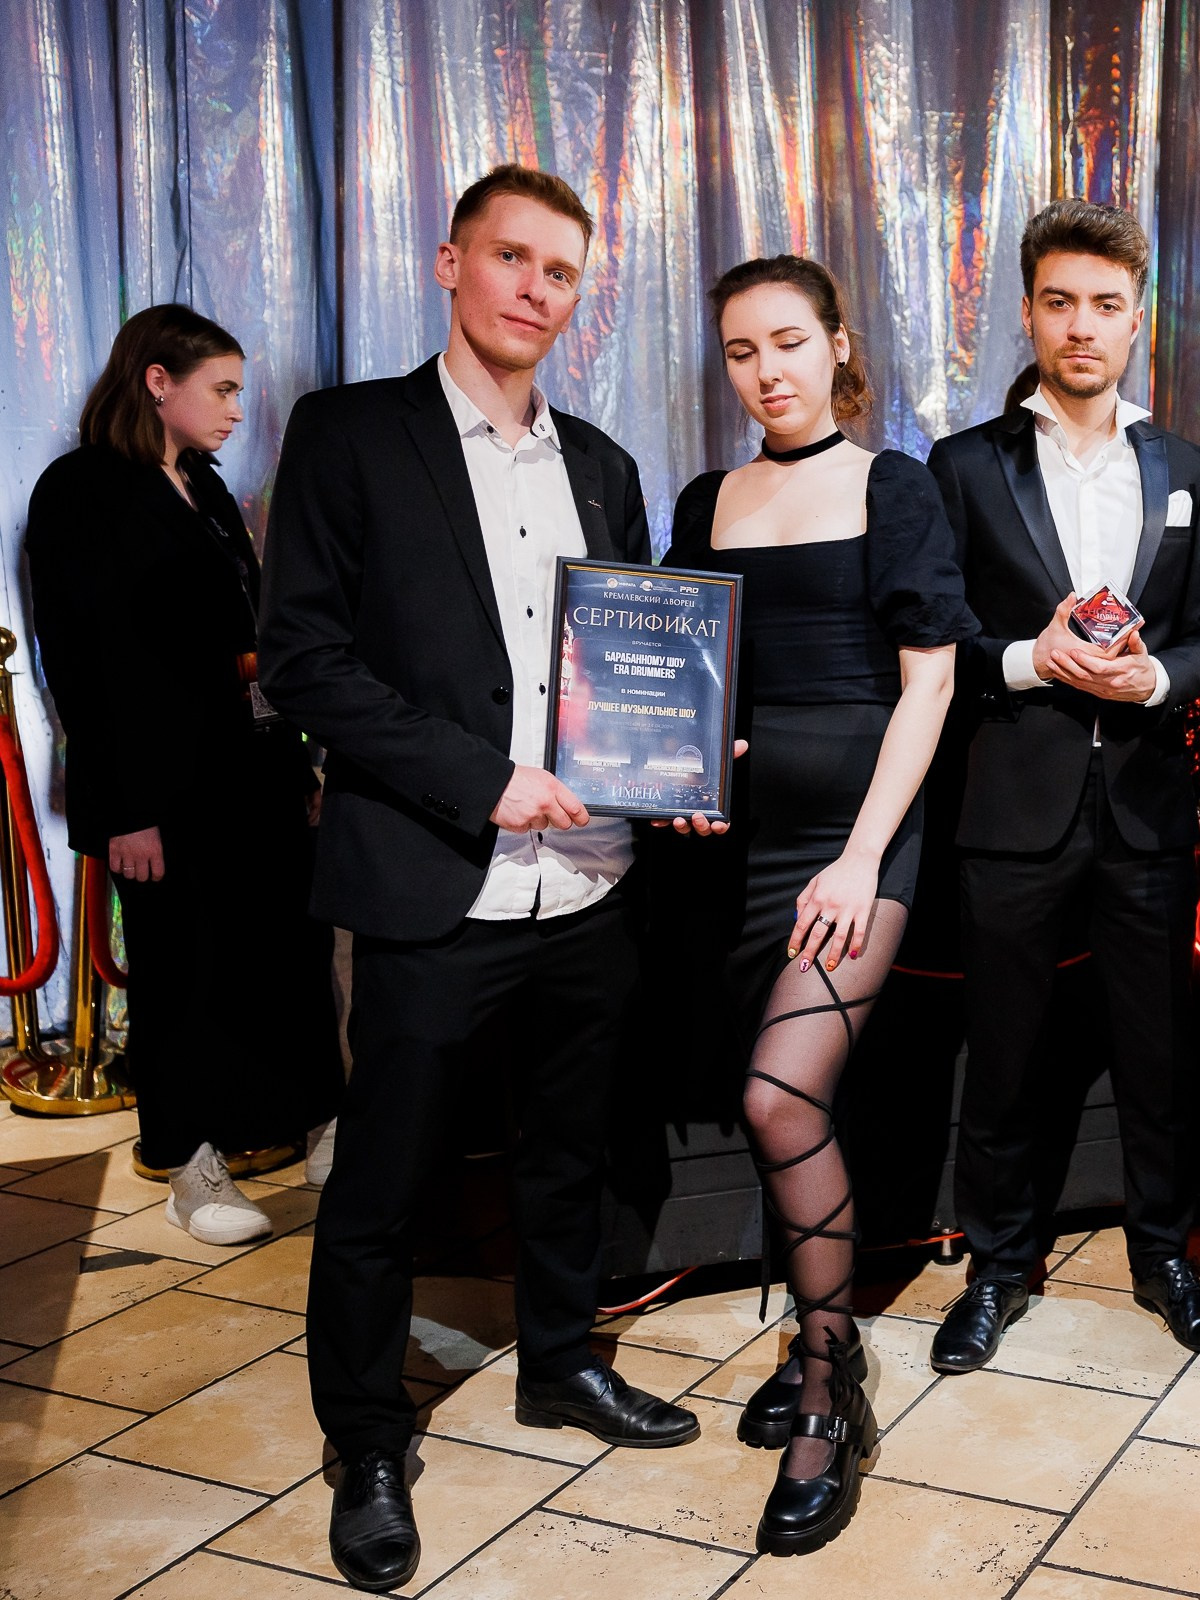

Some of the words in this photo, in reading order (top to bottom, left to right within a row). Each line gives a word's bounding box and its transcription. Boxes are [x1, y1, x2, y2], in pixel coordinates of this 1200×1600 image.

[680, 586, 699, 594] PRO
[603, 591, 660, 604] КРЕМЛЕВСКИЙ
[663, 598, 695, 607] ДВОРЕЦ
[573, 606, 720, 637] СЕРТИФИКАТ
[605, 651, 666, 666] БАРАБАННОМУ
[667, 657, 686, 668] ШОУ
[614, 664, 629, 675] ERA
[631, 666, 676, 679] DRUMMERS
[627, 689, 666, 697] номинации
[588, 701, 619, 711] ЛУЧШЕЕ
[621, 703, 678, 717] МУЗЫКАЛЬНОЕ
[679, 709, 696, 719] ШОУ
[612, 786, 662, 800] ИМЕНА
